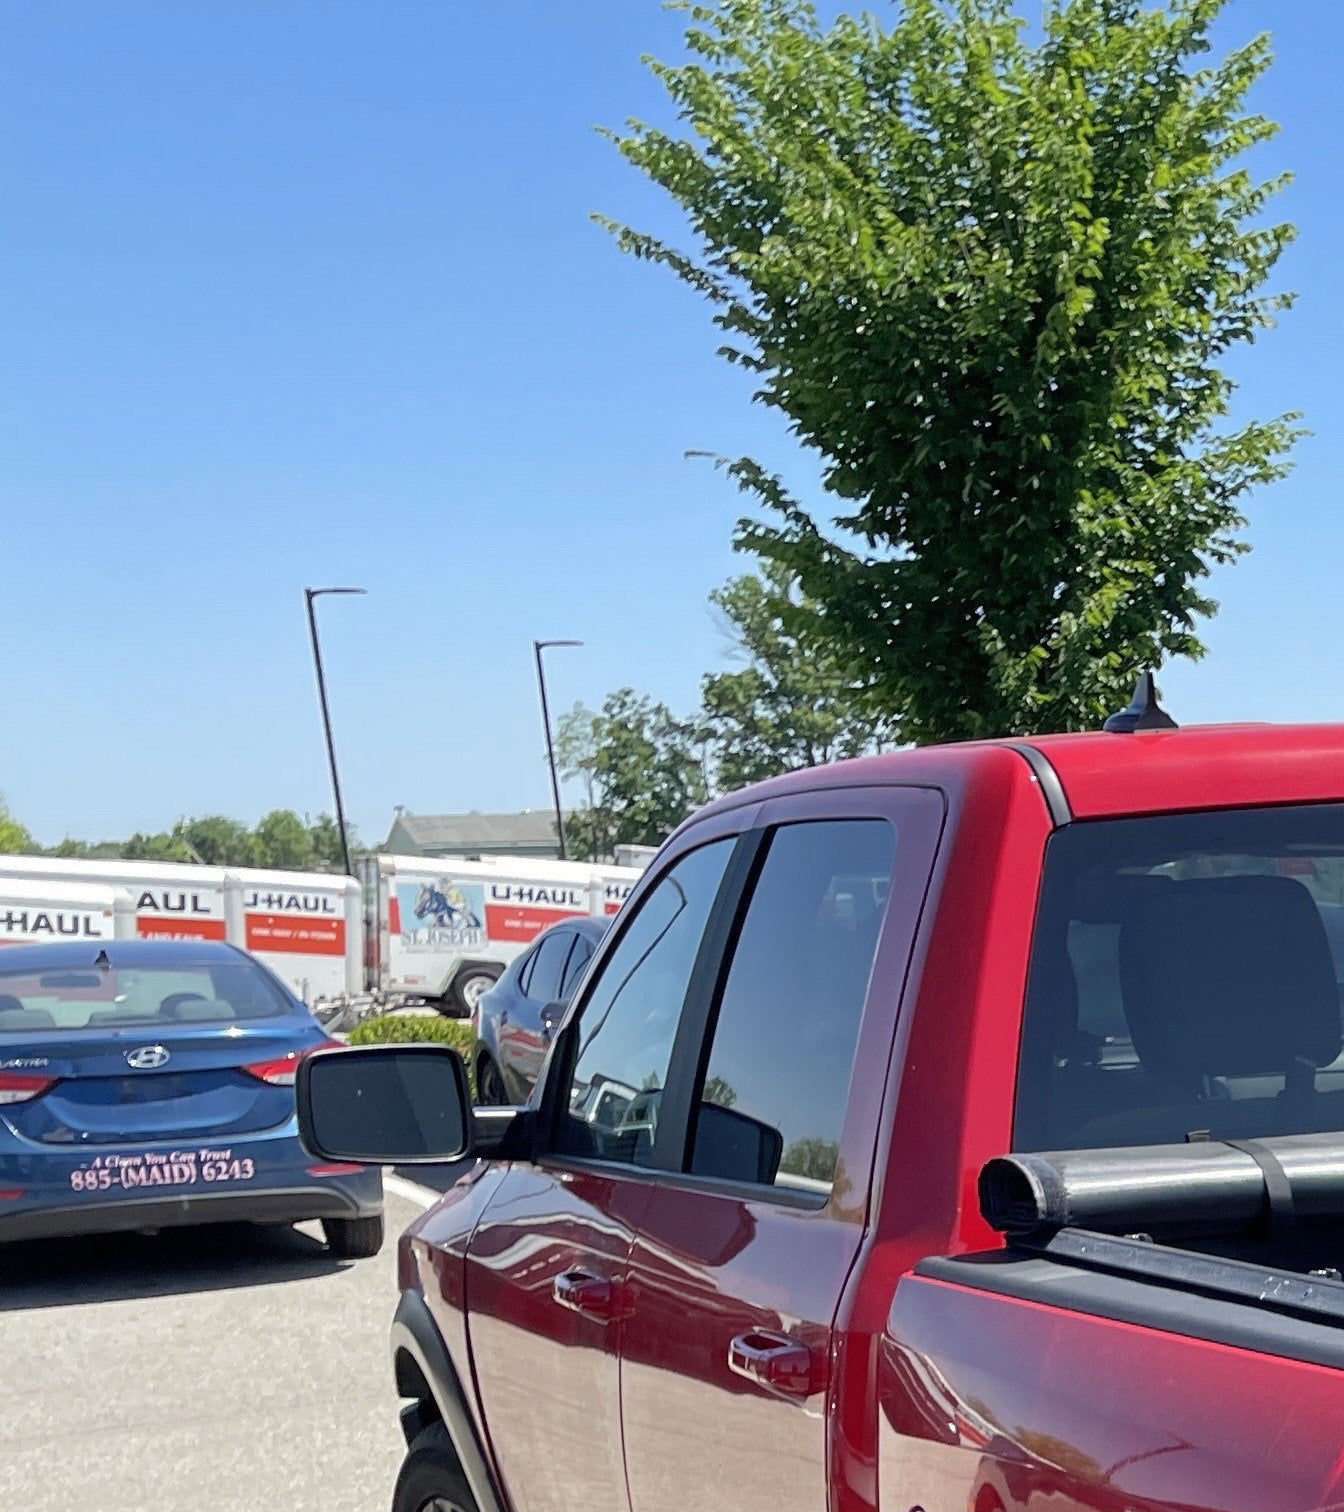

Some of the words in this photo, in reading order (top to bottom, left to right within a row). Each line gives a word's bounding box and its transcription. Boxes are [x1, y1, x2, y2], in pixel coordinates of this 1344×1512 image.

[137, 892, 210, 912] AUL
[492, 884, 582, 906] U-HAUL
[0, 910, 101, 936] -HAUL
